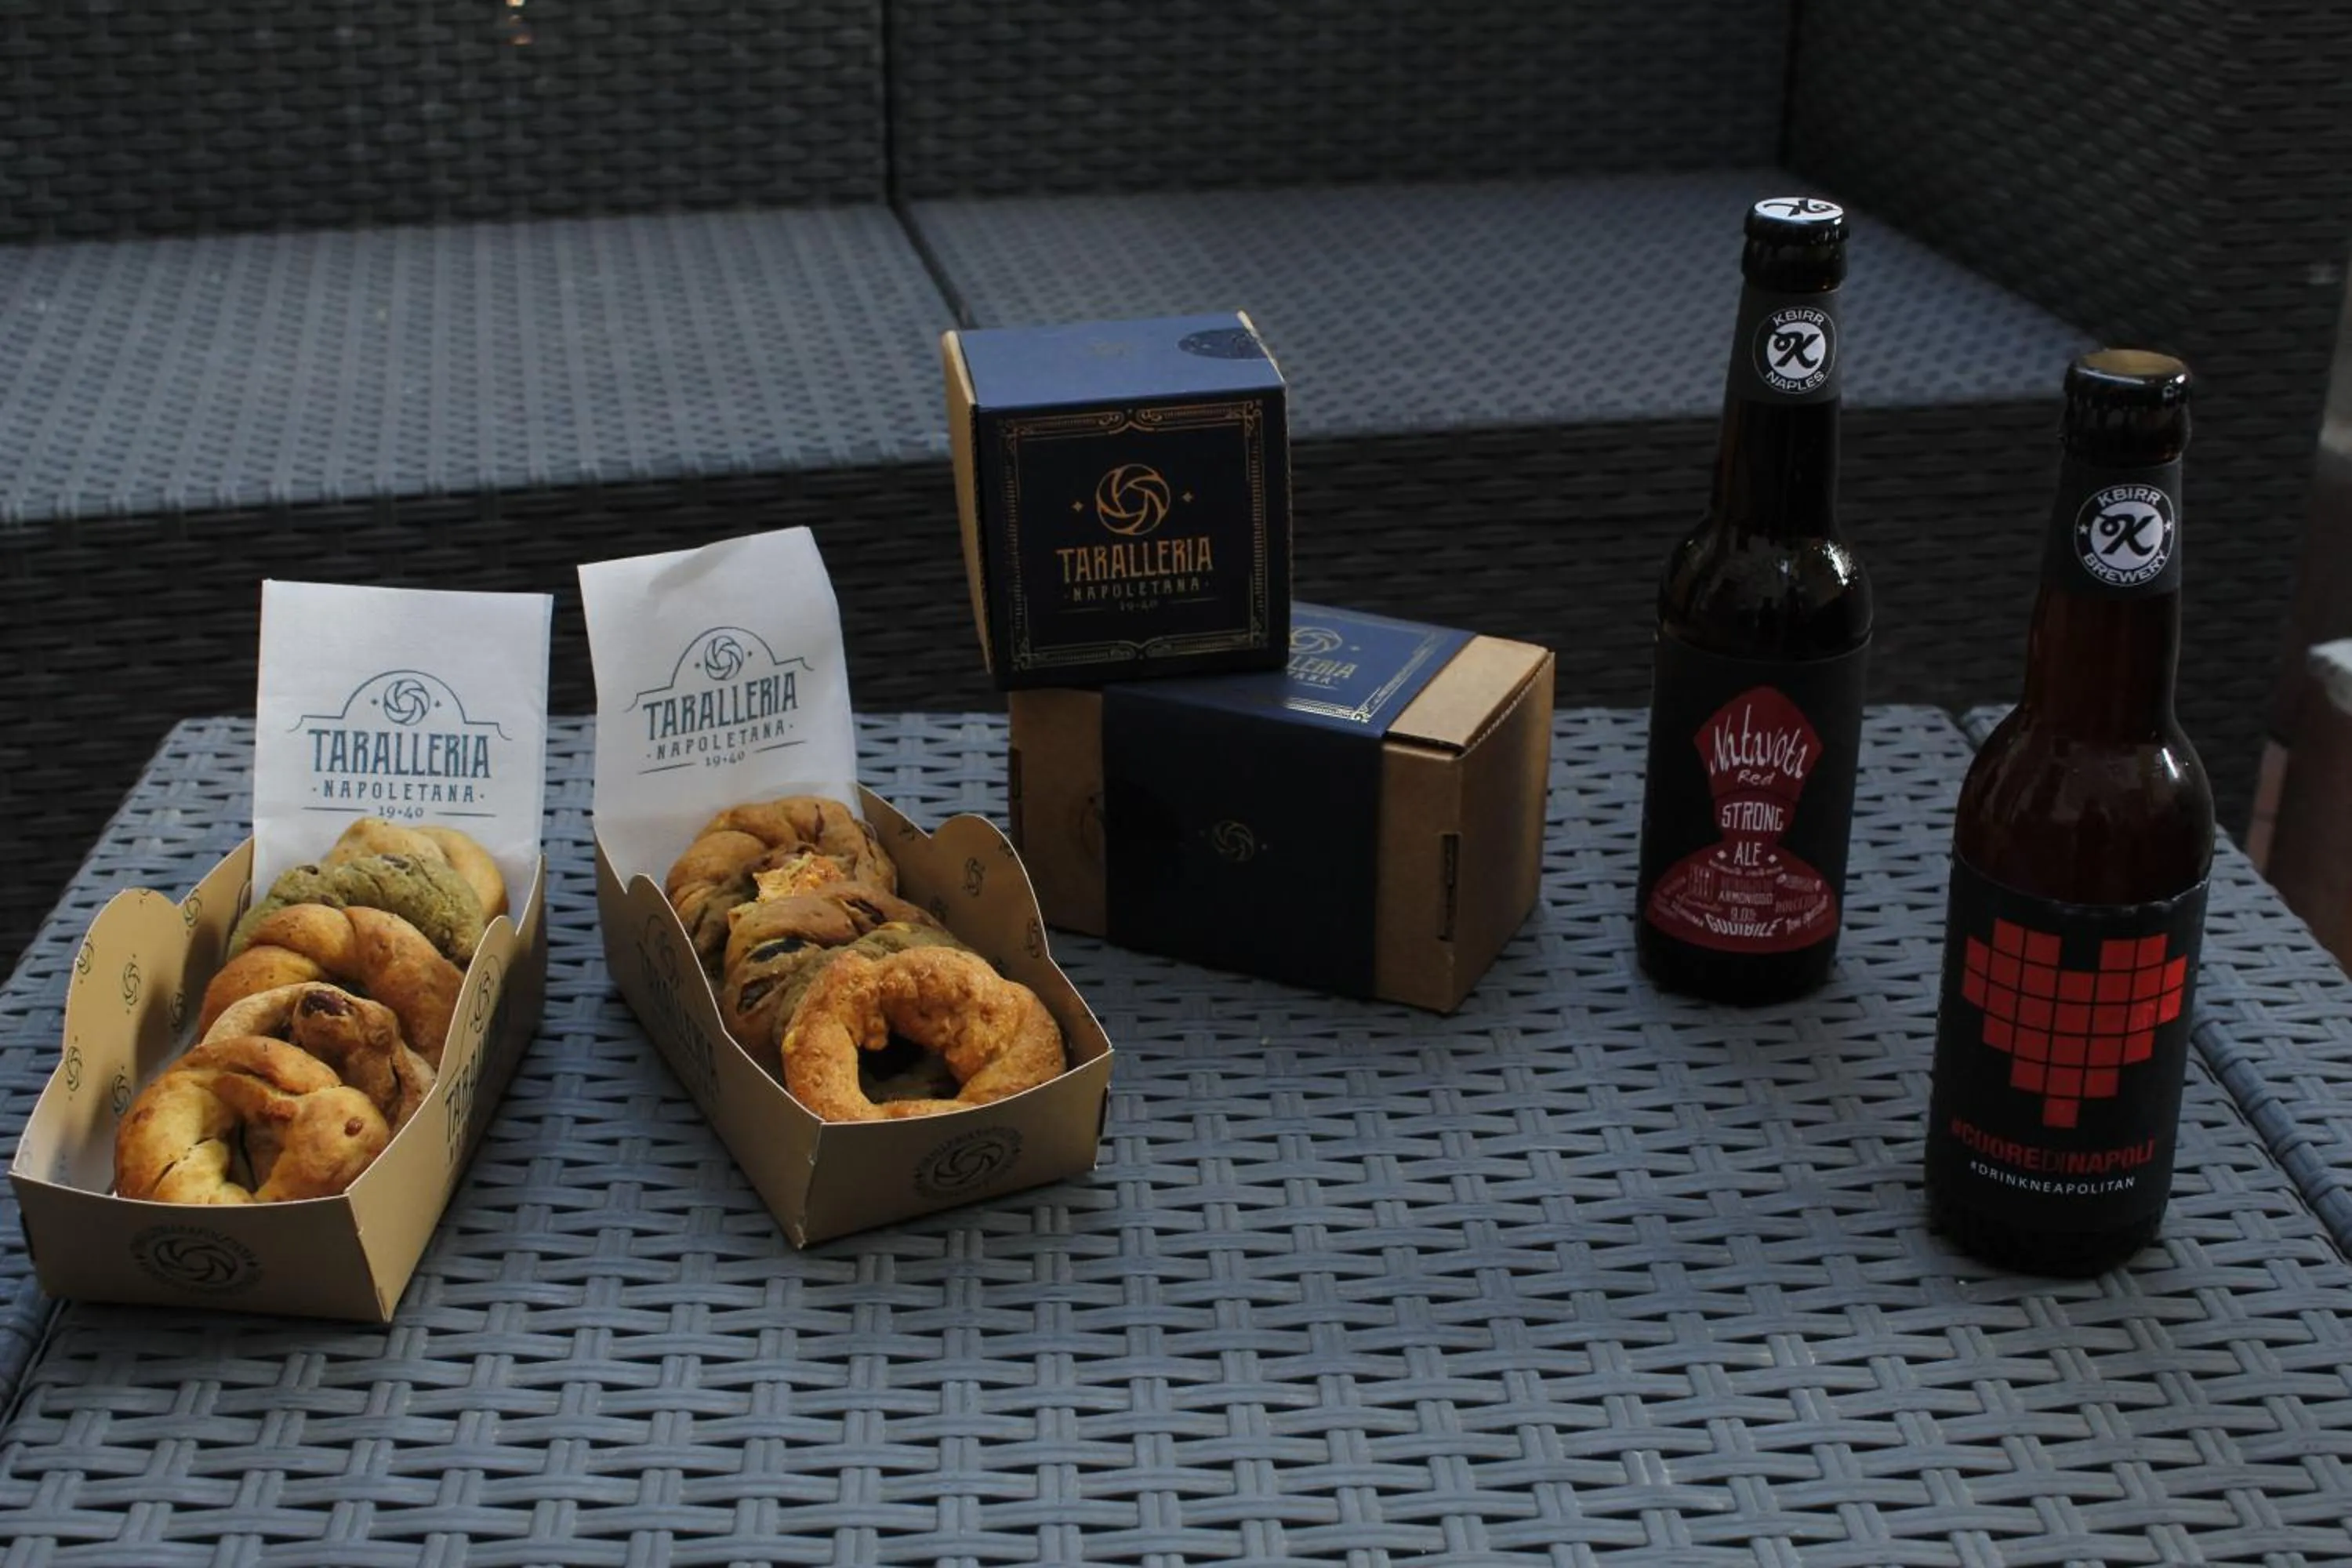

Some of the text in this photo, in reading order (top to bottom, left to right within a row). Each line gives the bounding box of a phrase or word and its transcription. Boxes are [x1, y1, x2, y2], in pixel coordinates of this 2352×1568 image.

[1772, 309, 1825, 327] KBIRR
[1766, 369, 1826, 391] NAPLES
[2096, 487, 2162, 508] KBIRR
[1055, 535, 1215, 584] TARALLERIA
[2082, 549, 2166, 583] BREWERY
[1072, 575, 1201, 603] NAPOLETANA
[642, 670, 798, 741] TARALLERIA
[307, 728, 492, 779] TARALLERIA
[655, 719, 785, 760] NAPOLETANA
[323, 779, 475, 803] NAPOLETANA
[1737, 768, 1777, 786] Red
[1720, 800, 1785, 832] STRONG
[1733, 841, 1764, 866] ALE
[1969, 1160, 2136, 1196] #DRINKNEAPOLITAN
